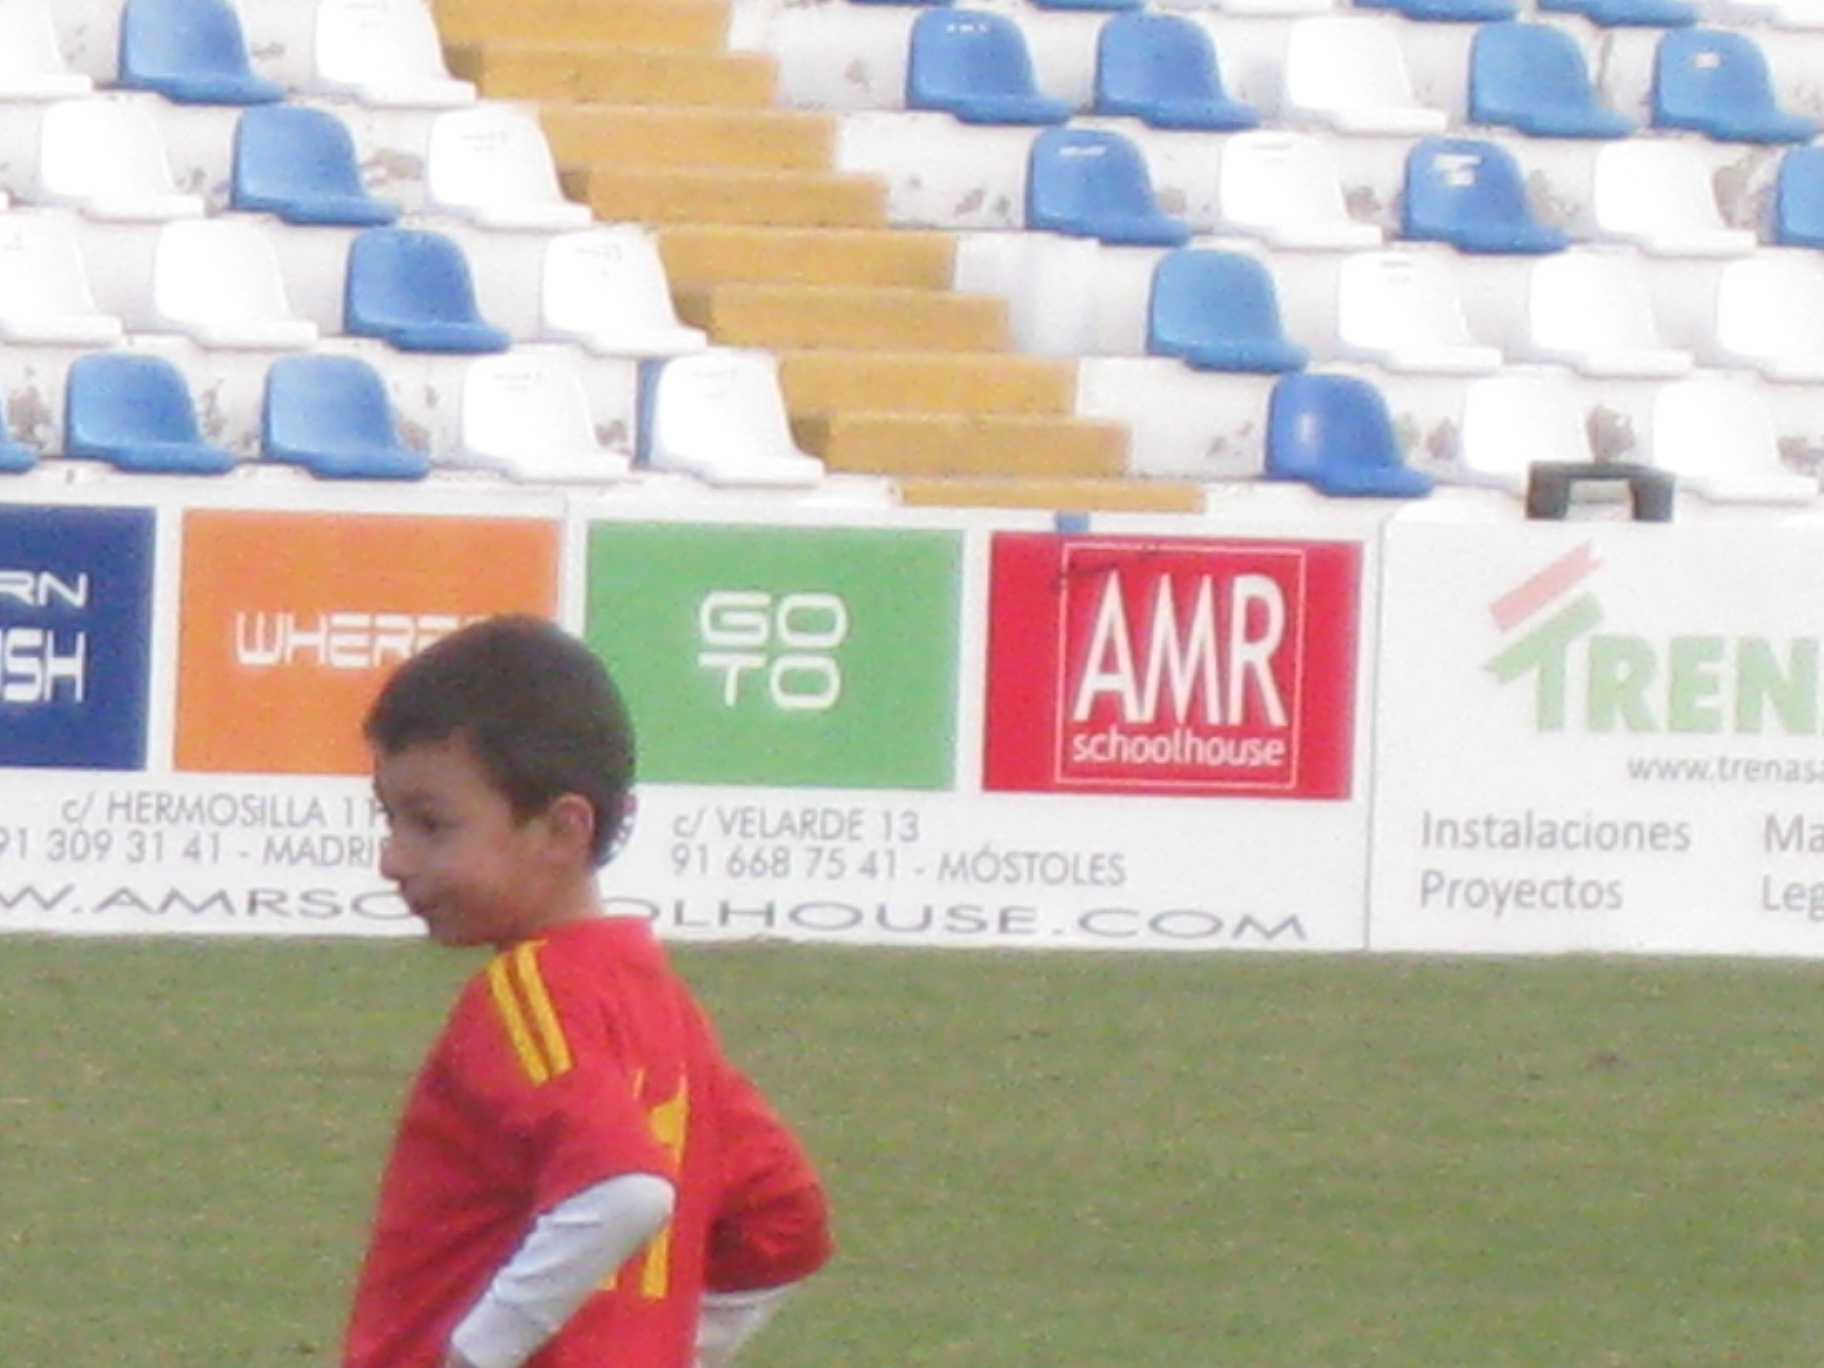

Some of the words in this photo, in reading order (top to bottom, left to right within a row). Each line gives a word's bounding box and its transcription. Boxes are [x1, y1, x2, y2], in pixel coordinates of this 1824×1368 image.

[699, 591, 848, 648] GO
[1072, 570, 1288, 727] AMR
[698, 653, 842, 710] TO
[1072, 724, 1287, 767] schoolhouse
[1627, 755, 1824, 783] www.trenas
[107, 791, 327, 828] HERMOSILLA
[717, 806, 863, 842] VELARDE
[880, 809, 920, 844] 13
[1421, 809, 1692, 852] Instalaciones
[46, 827, 113, 863] 309
[125, 828, 164, 864] 31
[181, 830, 221, 865] 41
[262, 833, 390, 868] MADRI
[670, 843, 709, 875] 91
[726, 844, 791, 879] 668
[805, 846, 846, 881] 75
[858, 848, 897, 880] 41
[936, 845, 1127, 887] MÓSTOLES
[1420, 868, 1624, 918] Proyectos
